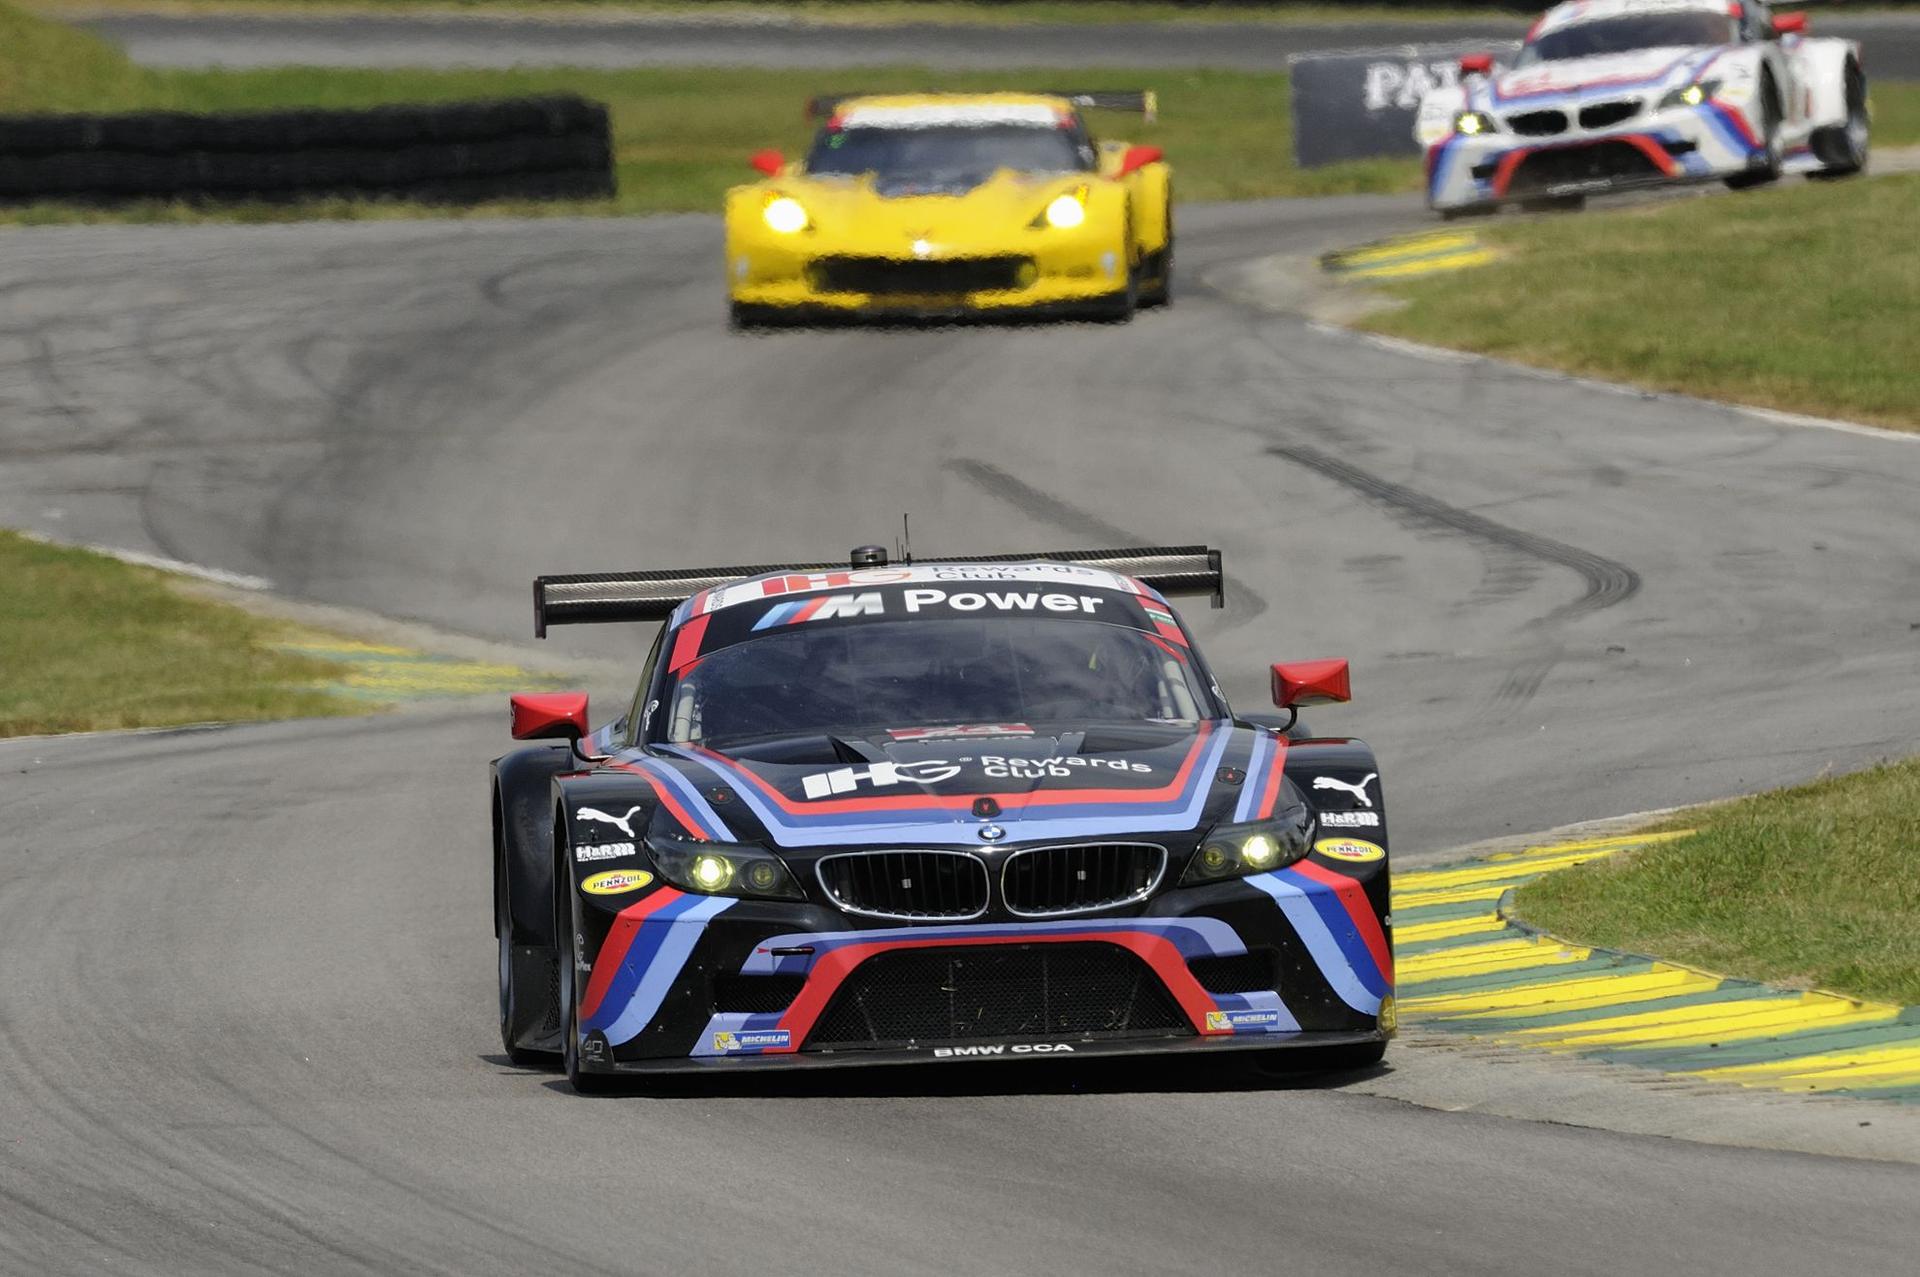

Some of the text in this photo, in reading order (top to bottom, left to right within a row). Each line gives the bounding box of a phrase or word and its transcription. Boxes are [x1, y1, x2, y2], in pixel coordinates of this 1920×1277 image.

[1365, 62, 1459, 110] PAT
[932, 565, 1095, 577] Rewards
[935, 571, 1017, 580] Club
[761, 570, 911, 597] IHG
[903, 588, 1104, 614] Power
[980, 755, 1153, 773] Rewards
[984, 765, 1071, 778] Club
[802, 760, 962, 800] IHG
[1326, 845, 1374, 855] PENNZOIL
[593, 874, 642, 889] PENNZOIL
[1233, 1014, 1277, 1024] MICHELIN
[741, 1035, 788, 1044] MICHELIN
[934, 1043, 1075, 1057] BMW CCA
